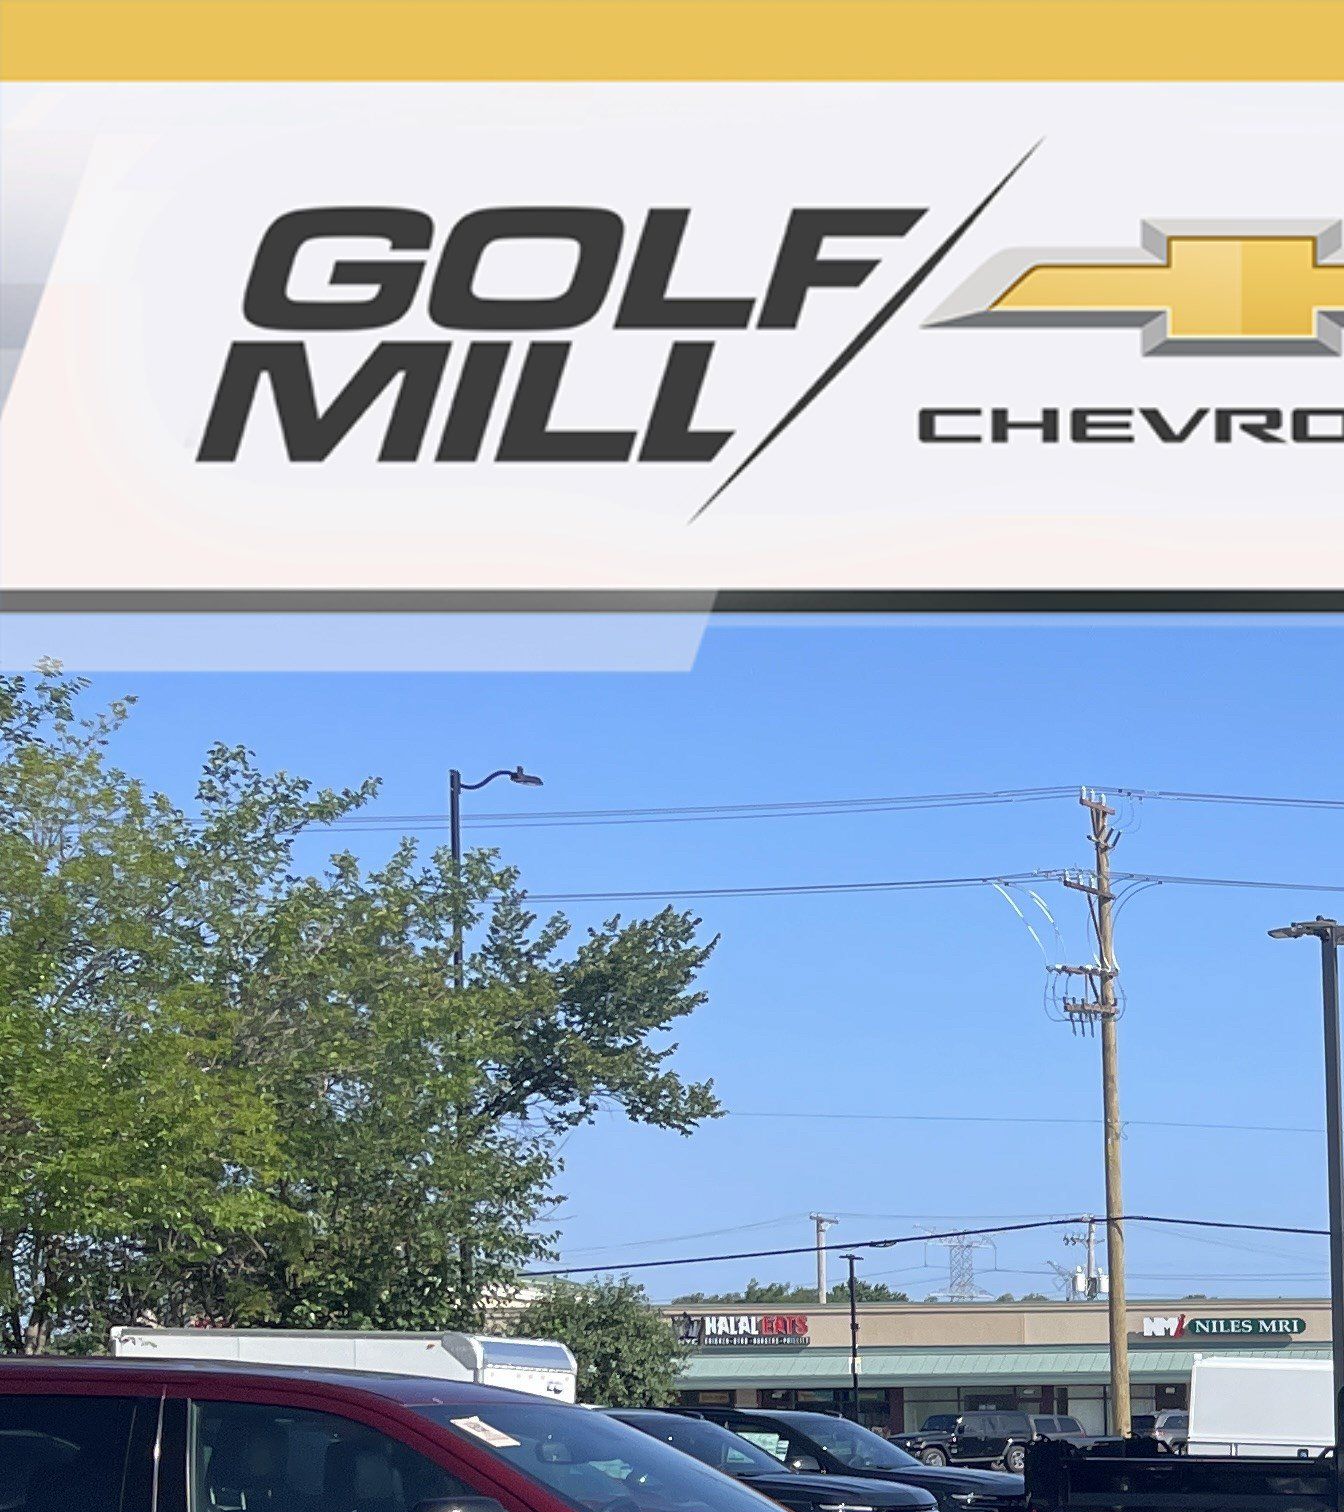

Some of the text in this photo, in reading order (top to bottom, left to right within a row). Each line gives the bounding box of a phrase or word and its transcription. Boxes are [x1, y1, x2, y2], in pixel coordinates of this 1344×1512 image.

[704, 1315, 808, 1336] HALAL EATS
[1195, 1319, 1299, 1333] NILES MRI
